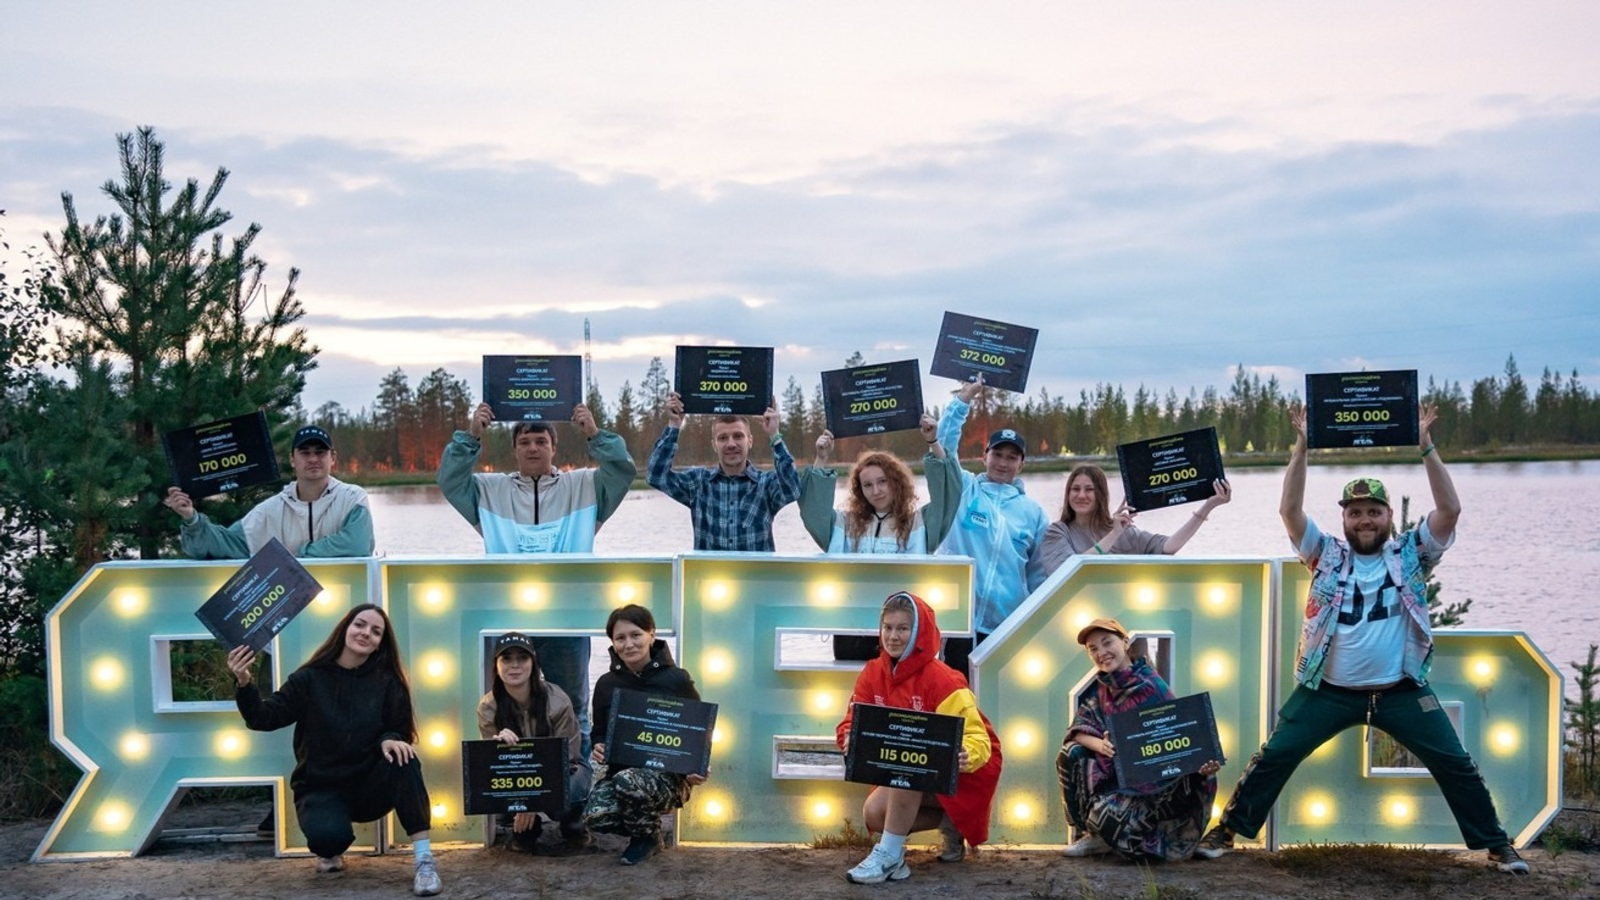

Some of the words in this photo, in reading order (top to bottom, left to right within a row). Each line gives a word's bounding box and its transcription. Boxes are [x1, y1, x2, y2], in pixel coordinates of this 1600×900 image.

[973, 330, 1004, 340] СЕРТИФИКАТ
[960, 349, 979, 361] 372
[982, 354, 1005, 366] 000
[700, 381, 720, 391] 370
[724, 382, 747, 392] 000
[855, 378, 886, 386] СЕРТИФИКАТ
[508, 389, 530, 399] 350
[533, 389, 557, 399] 000
[850, 402, 870, 413] 270
[874, 398, 897, 410] 000
[1335, 411, 1359, 422] 350
[1363, 410, 1390, 421] 000
[199, 432, 233, 445] СЕРТИФИКАТ
[1152, 447, 1185, 458] СЕРТИФИКАТ
[199, 460, 218, 473] 170
[221, 453, 247, 468] 000
[1149, 473, 1169, 486] 270
[1173, 468, 1197, 481] 000
[232, 574, 260, 601] СЕРТИФИКАТ
[241, 606, 263, 628] 200
[262, 585, 285, 607] 000
[500, 636, 530, 645] YAMAL
[647, 708, 681, 718] СЕРТИФИКАТ
[1143, 715, 1176, 727] СЕРТИФИКАТ
[889, 724, 925, 734] СЕРТИФИКАТ
[637, 731, 653, 743] 45
[656, 734, 681, 747] 000
[1141, 744, 1161, 757] 180
[1164, 737, 1190, 751] 000
[880, 748, 897, 761] 115
[901, 751, 928, 765] 000
[491, 778, 513, 789] 335
[517, 777, 542, 787] 000
